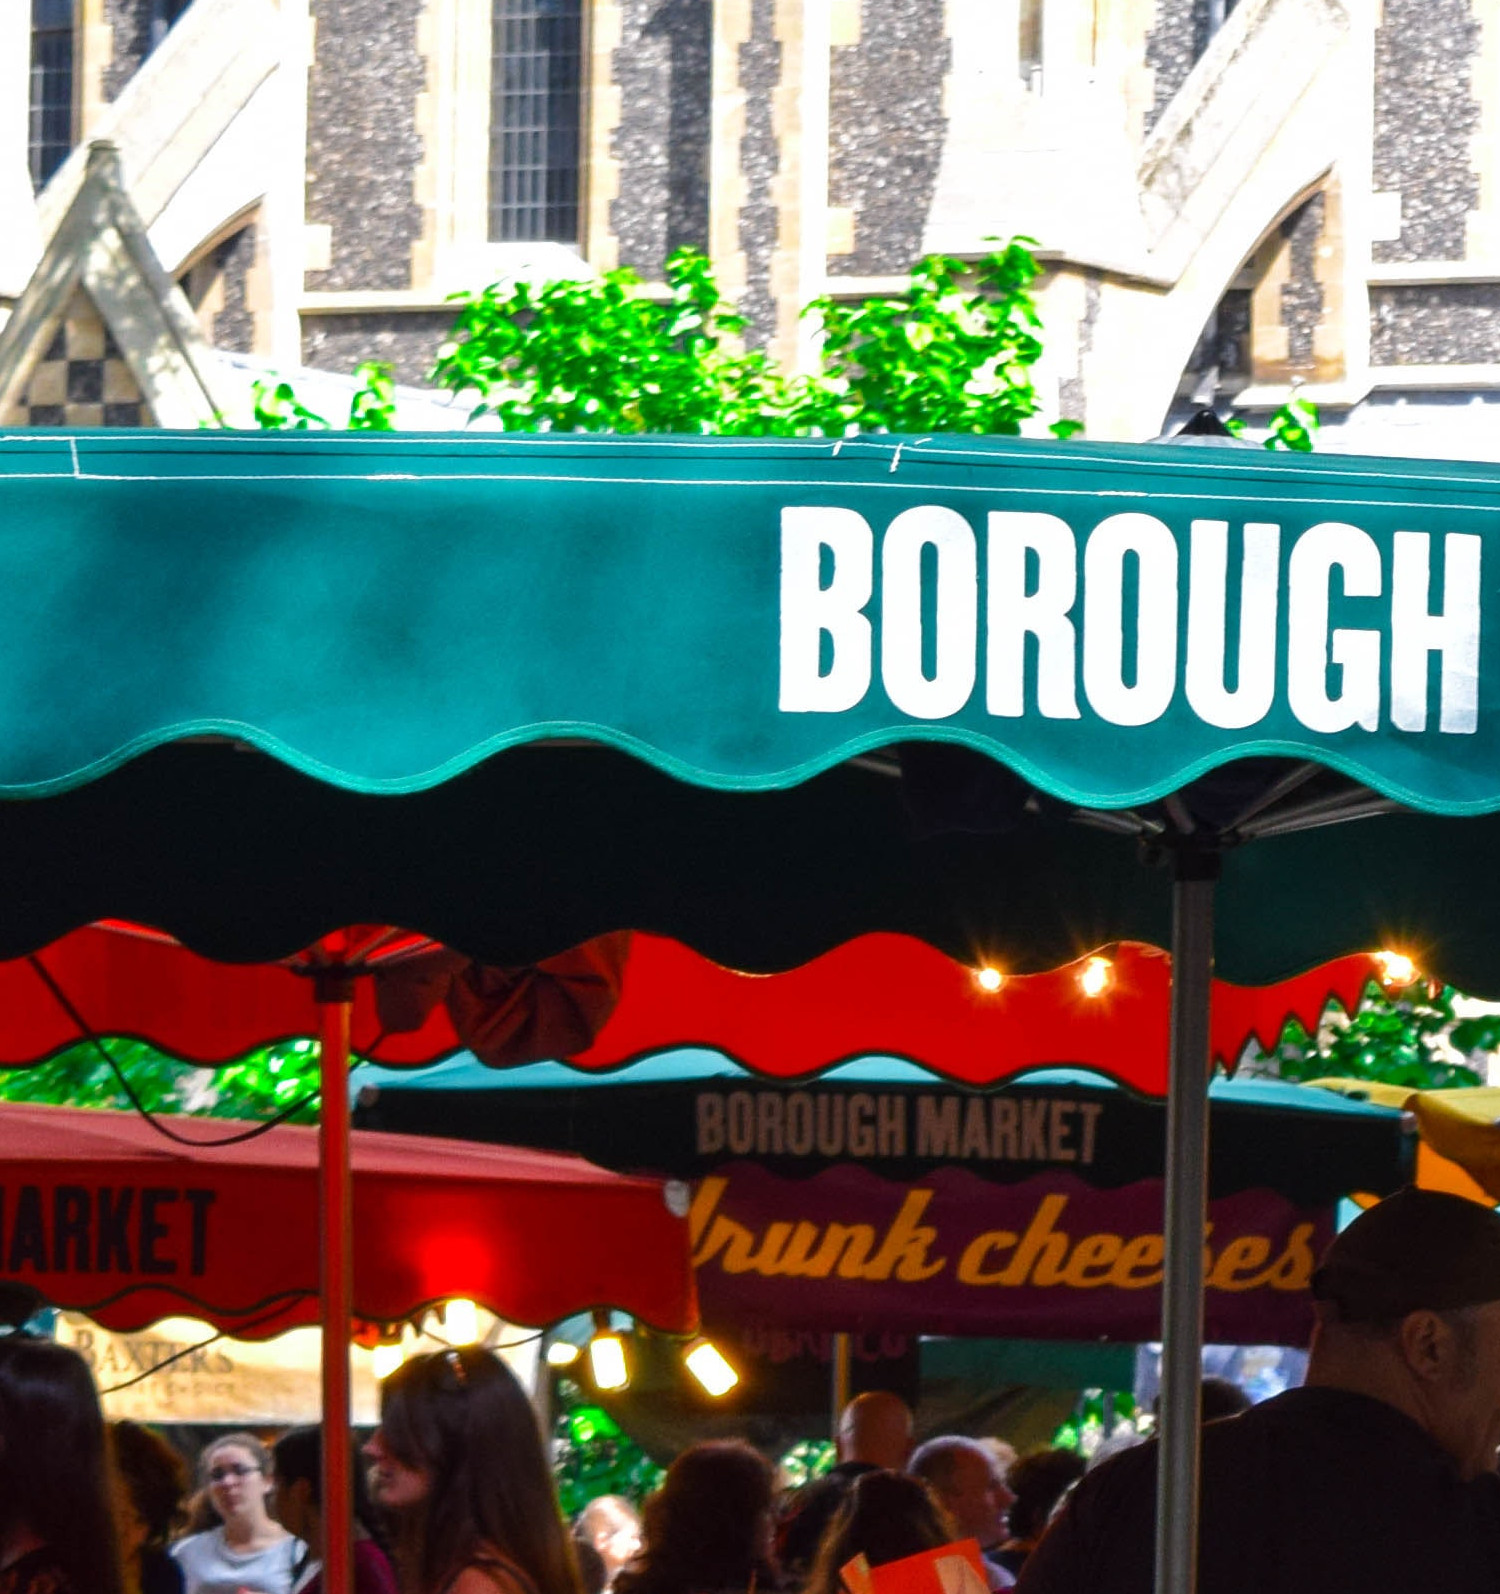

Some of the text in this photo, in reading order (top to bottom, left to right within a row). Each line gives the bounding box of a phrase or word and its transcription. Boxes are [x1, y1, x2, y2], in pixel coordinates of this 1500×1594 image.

[779, 505, 1482, 736] BOROUGH
[696, 1091, 1104, 1165] BOROUGH MARKET
[0, 1185, 217, 1277] ARKET
[956, 1194, 1316, 1291] cheees
